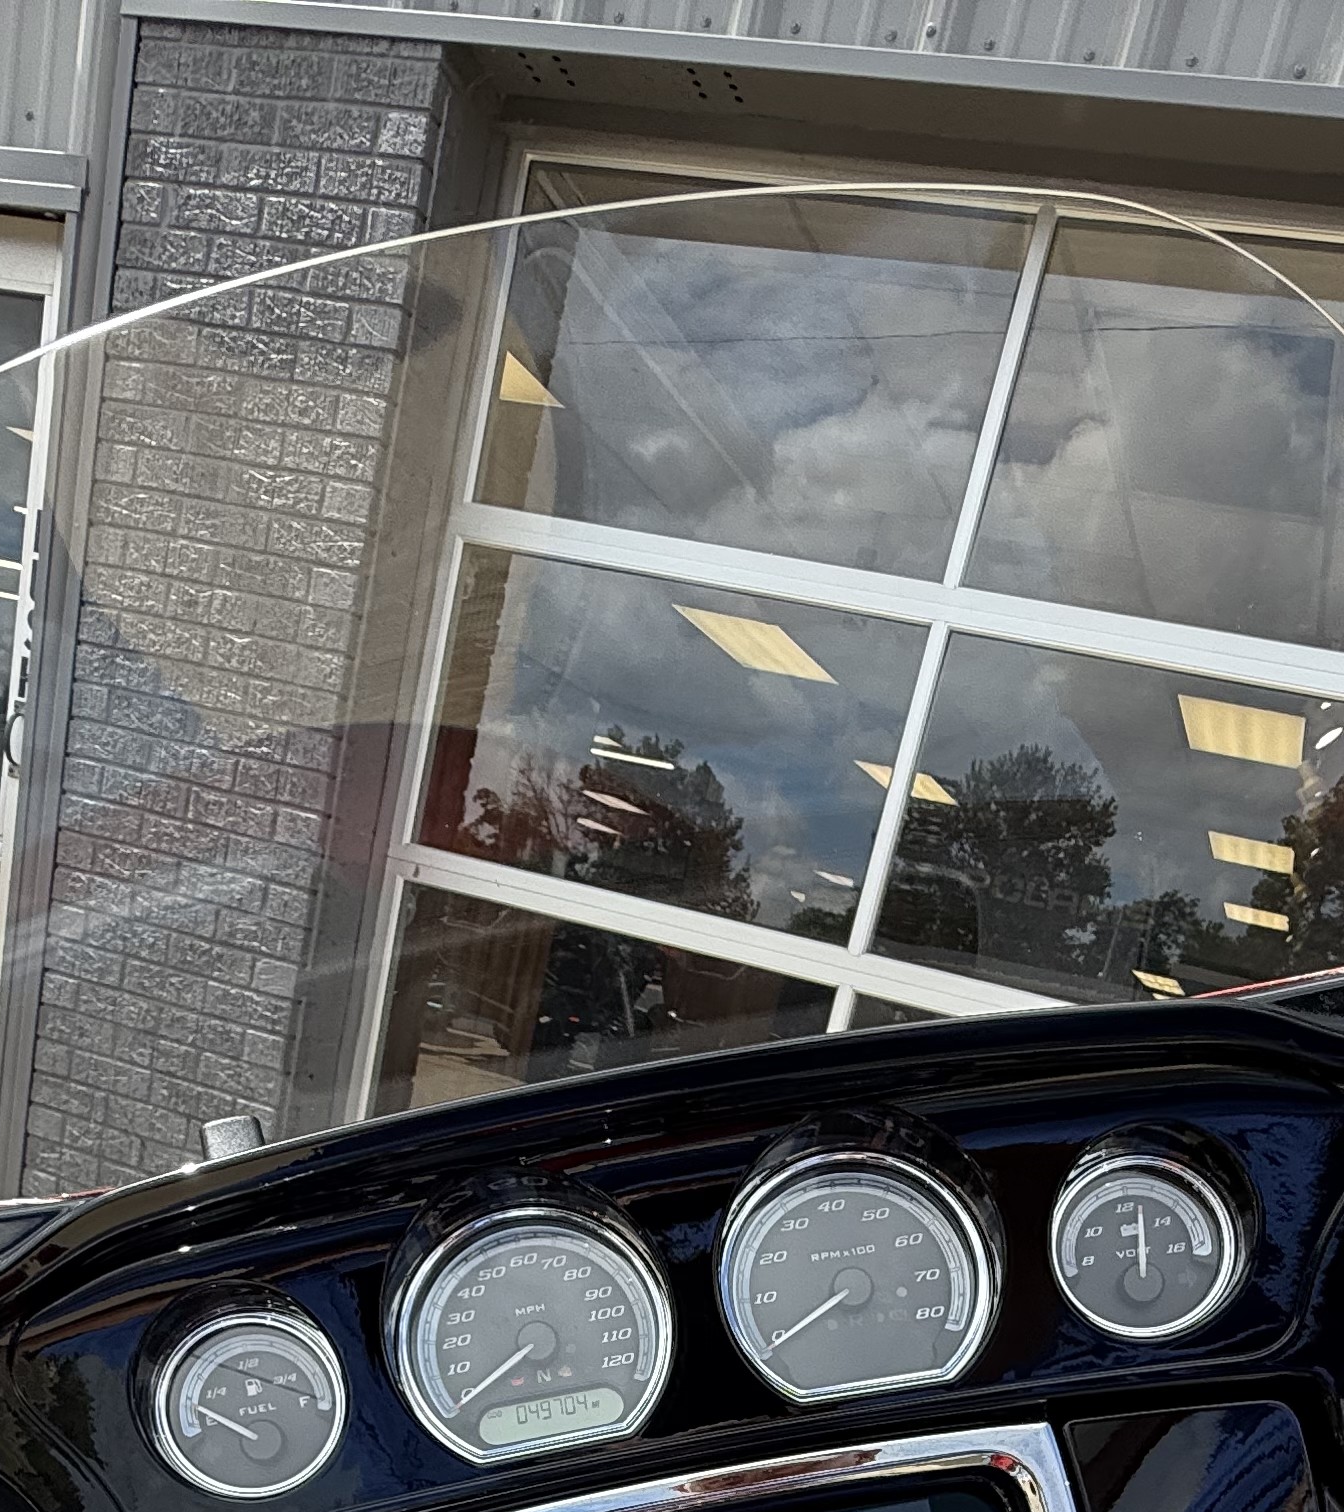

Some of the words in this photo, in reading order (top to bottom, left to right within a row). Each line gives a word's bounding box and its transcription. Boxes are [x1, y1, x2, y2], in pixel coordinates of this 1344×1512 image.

[817, 1200, 845, 1212] 40
[1116, 1202, 1134, 1213] 12
[860, 1208, 890, 1222] 50
[1154, 1216, 1171, 1227] 14
[781, 1218, 809, 1231] 30
[1084, 1226, 1103, 1238] 10
[895, 1233, 923, 1248] 60
[1116, 1246, 1151, 1259] VOT
[1166, 1242, 1186, 1254] 16
[510, 1253, 537, 1267] 60
[541, 1255, 567, 1269] 70
[759, 1251, 787, 1265] 20
[1082, 1256, 1095, 1266] 8
[477, 1267, 505, 1281] 50
[563, 1267, 591, 1281] 80
[914, 1269, 940, 1282] 70
[457, 1285, 485, 1298] 40
[584, 1287, 612, 1301] 90
[754, 1292, 777, 1304] 10
[515, 1304, 546, 1316] MPH
[588, 1305, 625, 1321] 100
[915, 1306, 945, 1319] 80
[447, 1310, 475, 1325] 30
[443, 1334, 472, 1349] 20
[601, 1328, 632, 1343] 110
[237, 1358, 259, 1370] 1/2
[601, 1353, 634, 1368] 120
[447, 1361, 471, 1376] 10
[273, 1373, 297, 1385] 3/4
[537, 1369, 552, 1384] N
[206, 1387, 227, 1399] 1/4
[299, 1396, 310, 1408] F
[239, 1403, 277, 1416] FUEL
[516, 1394, 588, 1425] 049704
